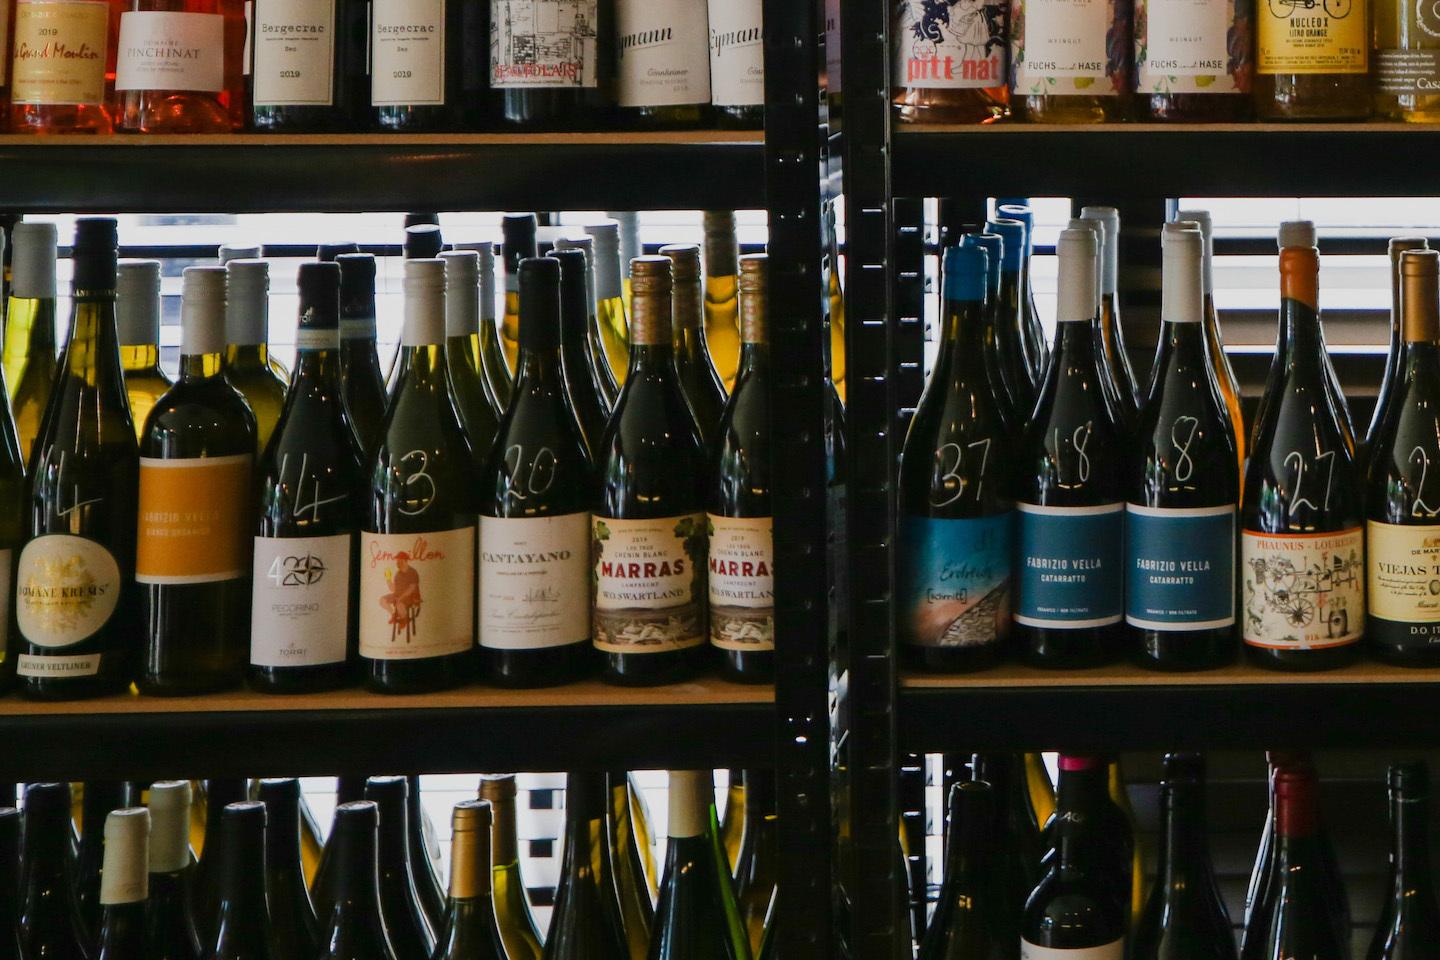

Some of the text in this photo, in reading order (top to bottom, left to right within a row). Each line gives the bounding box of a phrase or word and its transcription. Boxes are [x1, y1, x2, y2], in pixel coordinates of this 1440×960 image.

[1290, 17, 1321, 28] NUCLEO
[53, 41, 99, 60] Moulin
[127, 47, 200, 59] PINCHINAT
[907, 55, 1000, 82] pitt nat
[1028, 61, 1102, 71] FUCHS HASE
[1150, 59, 1223, 70] FUCHS HASE
[279, 70, 301, 78] 2019
[393, 70, 412, 78] 2019
[1054, 420, 1093, 483] 18
[503, 443, 559, 501] 20
[929, 438, 992, 508] 37
[1284, 450, 1337, 518] 27
[1256, 540, 1304, 551] PHAUNUS
[482, 550, 571, 564] CANTAYANO
[1027, 556, 1102, 570] FABRIZIO VELLA
[602, 559, 685, 579] MARRAS
[1136, 558, 1211, 572] FABRIZIO VELLA
[1377, 561, 1428, 576] VIEJAS
[1041, 574, 1086, 583] CATARRATTO
[1149, 575, 1194, 585] CATARRATTO
[62, 583, 106, 598] KREMS
